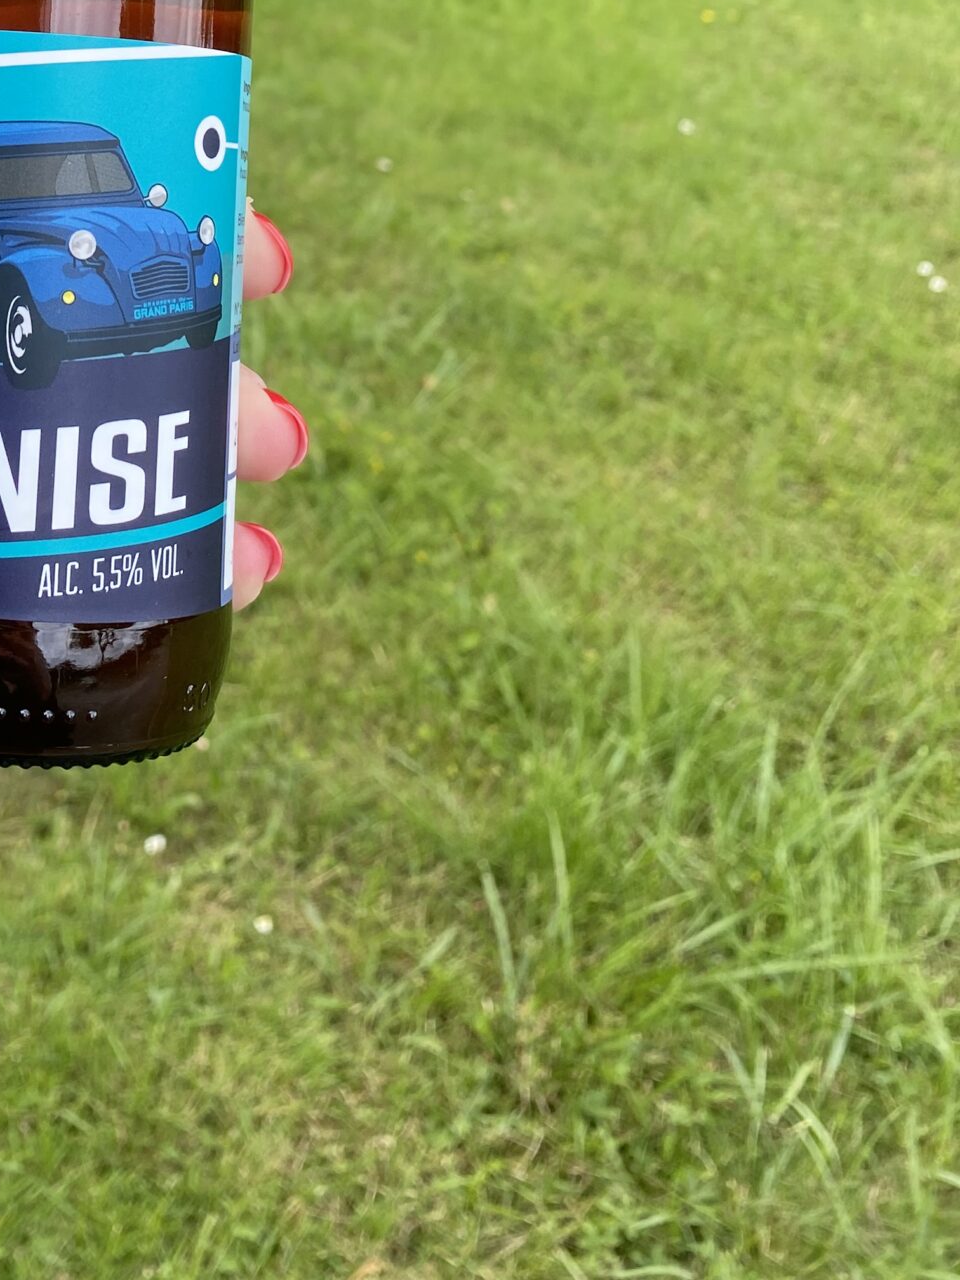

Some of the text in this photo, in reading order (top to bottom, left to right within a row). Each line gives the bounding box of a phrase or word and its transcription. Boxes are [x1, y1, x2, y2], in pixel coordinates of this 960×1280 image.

[133, 305, 168, 320] GRAND
[169, 300, 194, 314] PARIS
[37, 543, 184, 598] ALC. 5,5% VOL.
